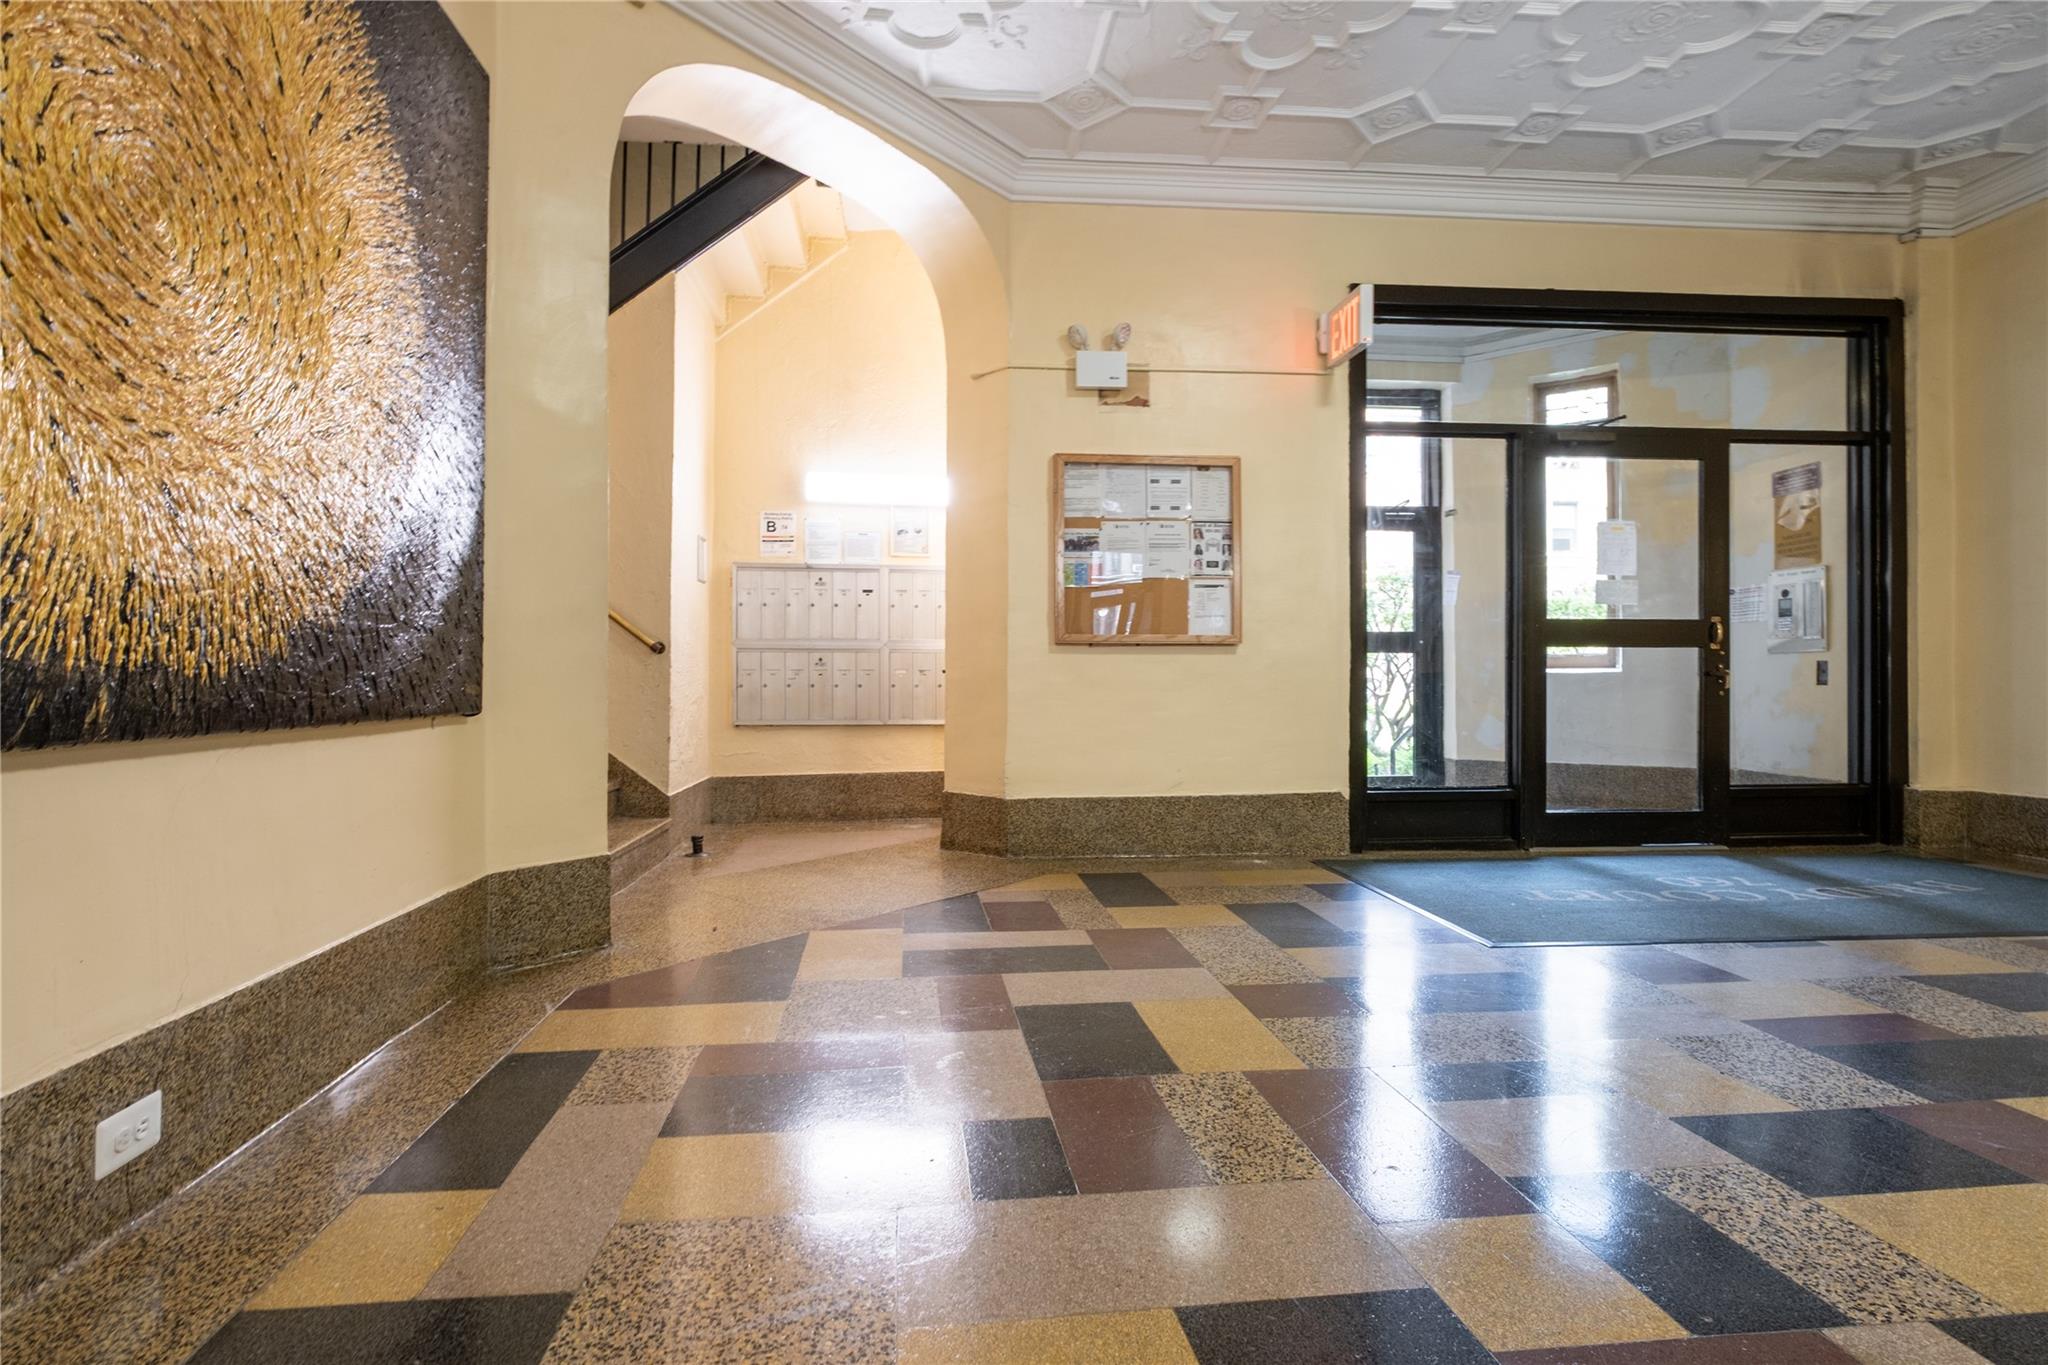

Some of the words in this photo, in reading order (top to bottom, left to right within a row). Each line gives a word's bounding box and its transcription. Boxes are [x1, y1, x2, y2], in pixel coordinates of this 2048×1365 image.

[1331, 294, 1361, 359] EXIT
[766, 520, 777, 533] B
[1653, 875, 1776, 888] 760
[1524, 889, 1769, 903] COURT
[1768, 879, 1984, 901] BRADY
